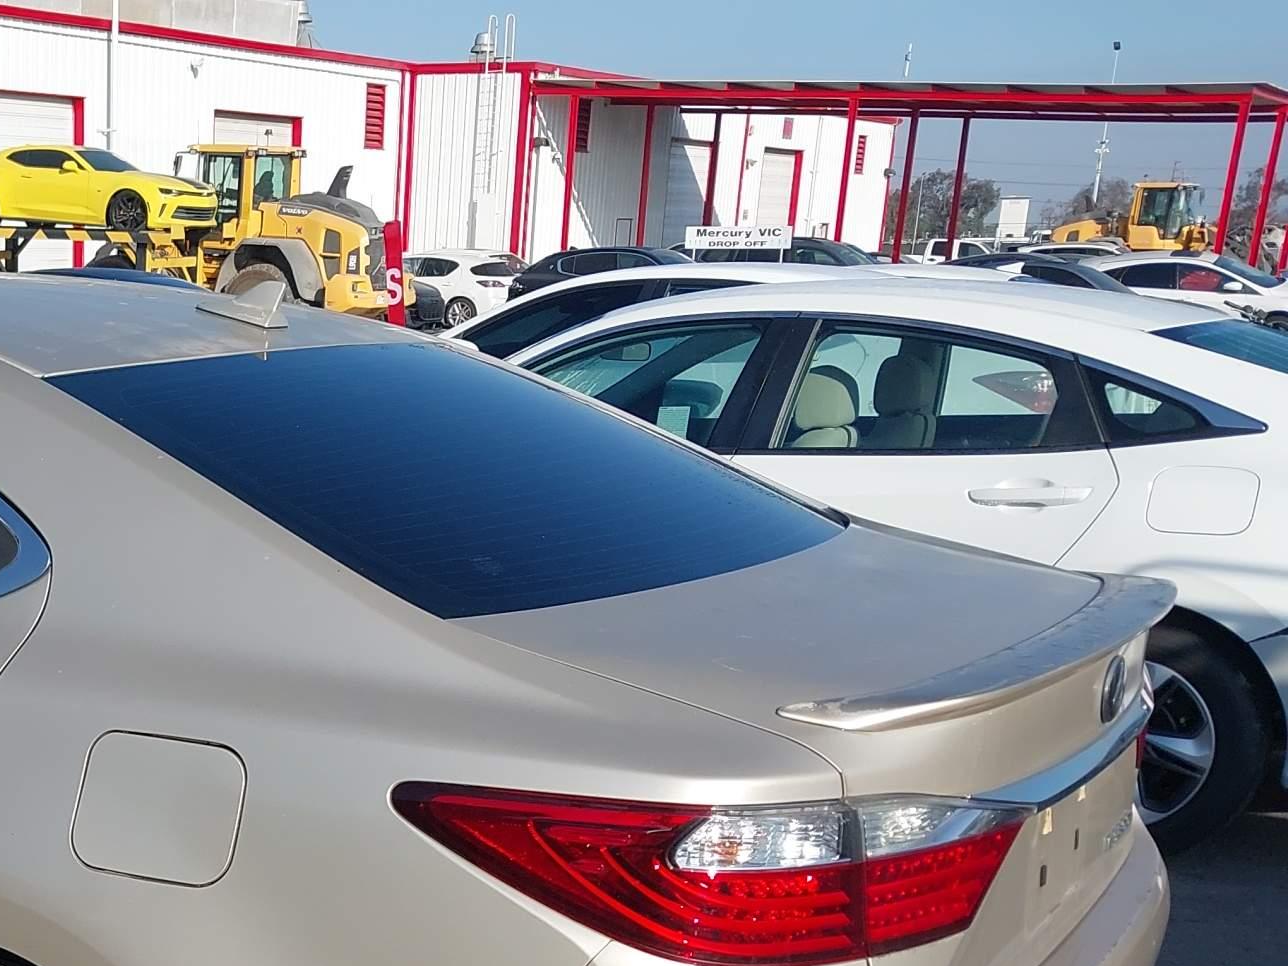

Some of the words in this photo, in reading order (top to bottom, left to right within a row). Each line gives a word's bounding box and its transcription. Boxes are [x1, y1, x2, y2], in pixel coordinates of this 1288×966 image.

[281, 207, 308, 215] VOLVO
[696, 228, 752, 239] Mercury
[758, 228, 782, 237] VIC
[386, 267, 403, 305] S
